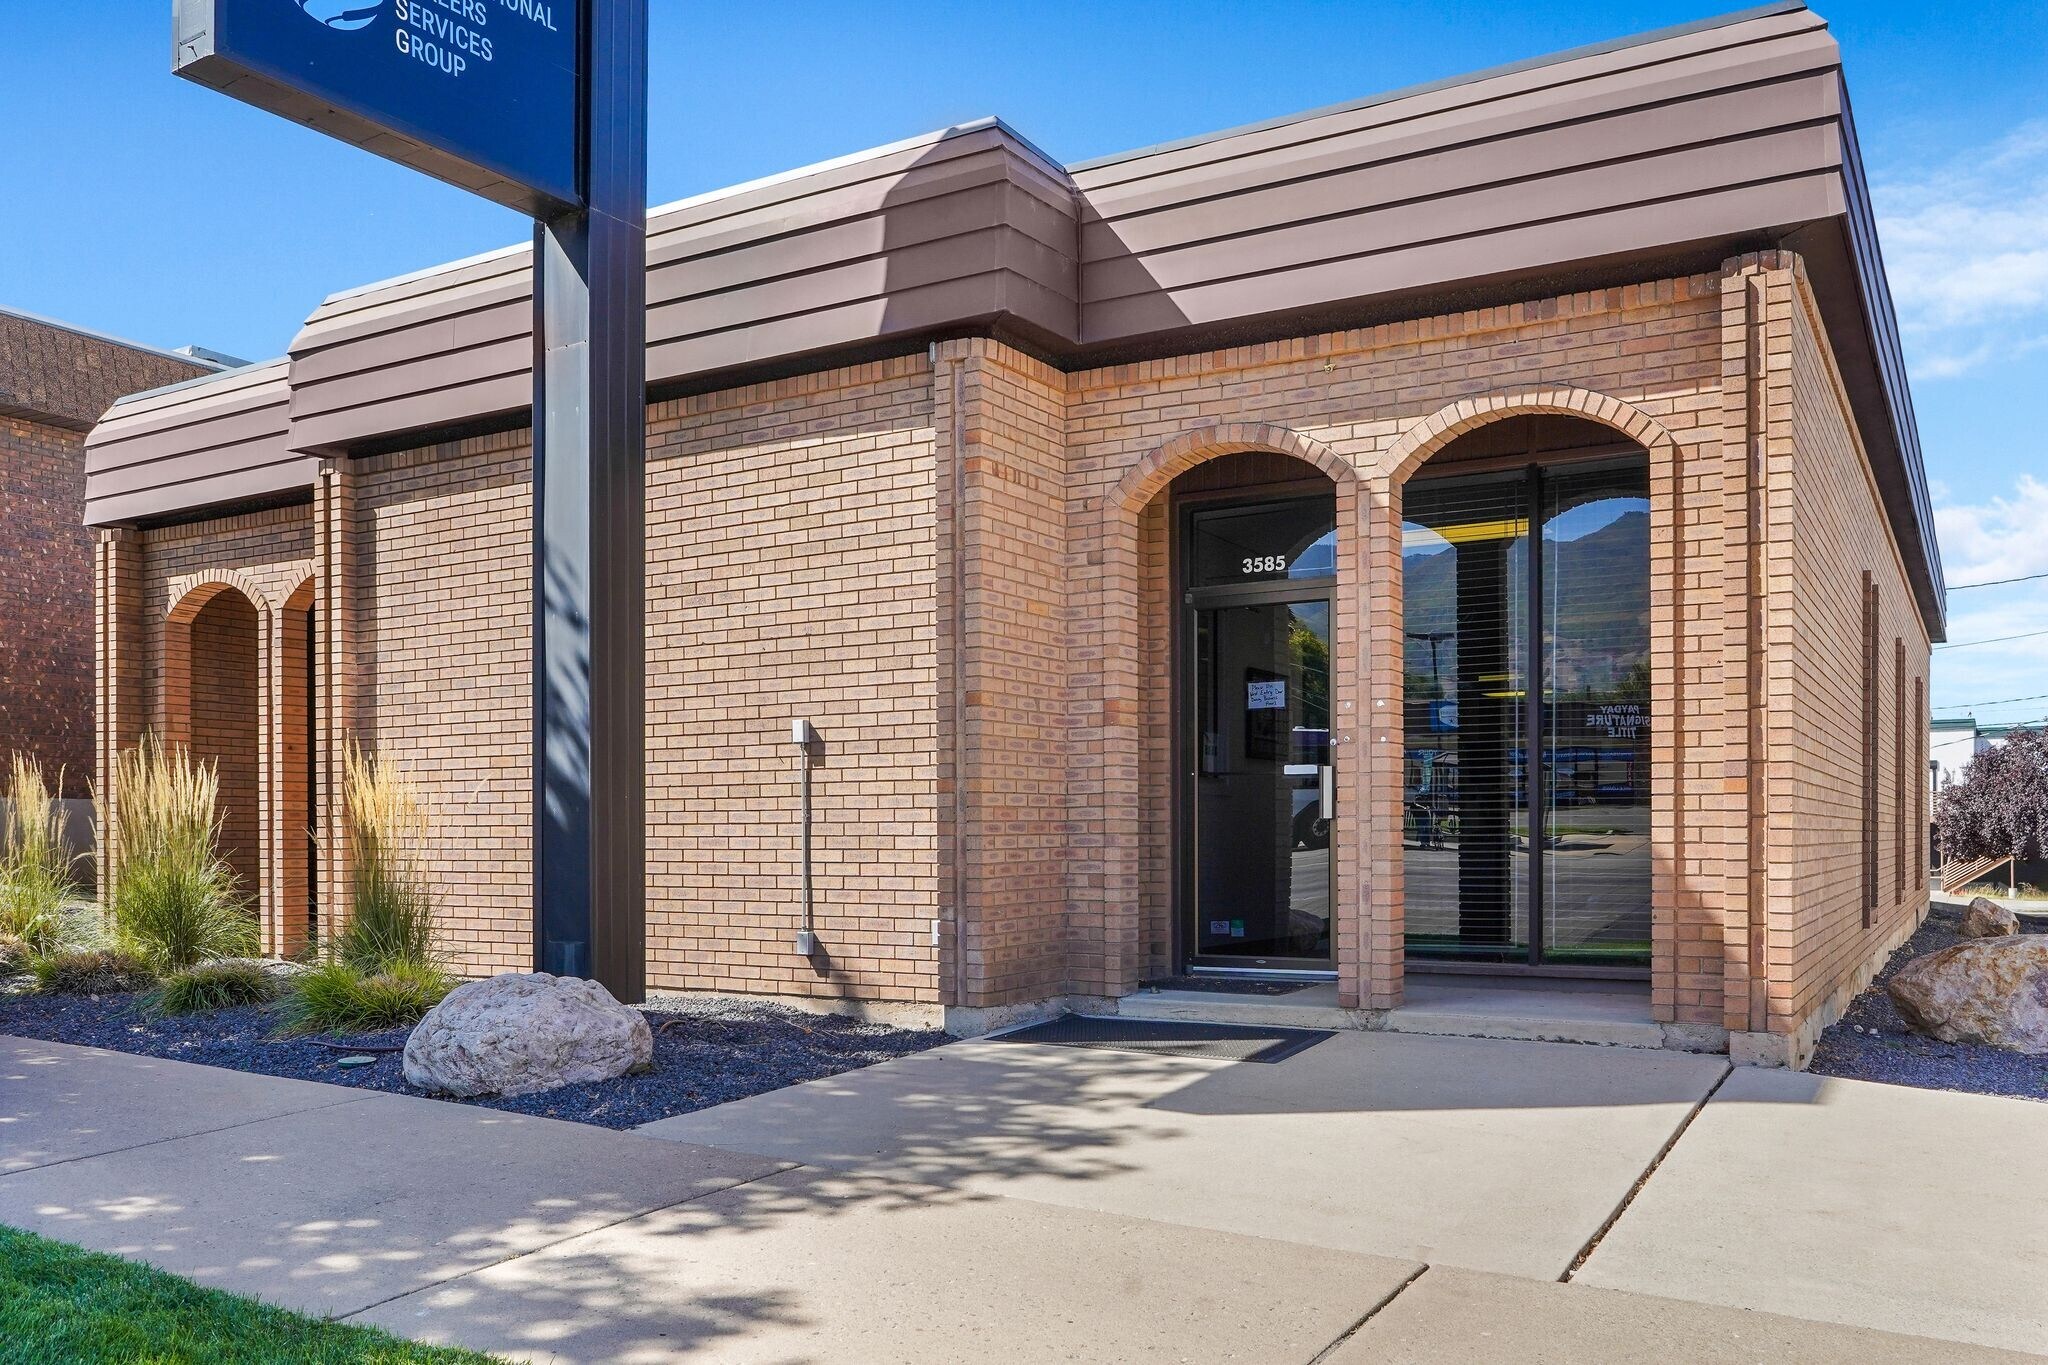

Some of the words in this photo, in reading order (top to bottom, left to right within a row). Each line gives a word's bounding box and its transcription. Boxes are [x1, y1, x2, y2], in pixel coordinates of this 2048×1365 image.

[395, 0, 493, 62] SERVICES
[501, 0, 557, 31] ONAL
[396, 28, 466, 77] GROUP
[1242, 555, 1286, 574] 3585
